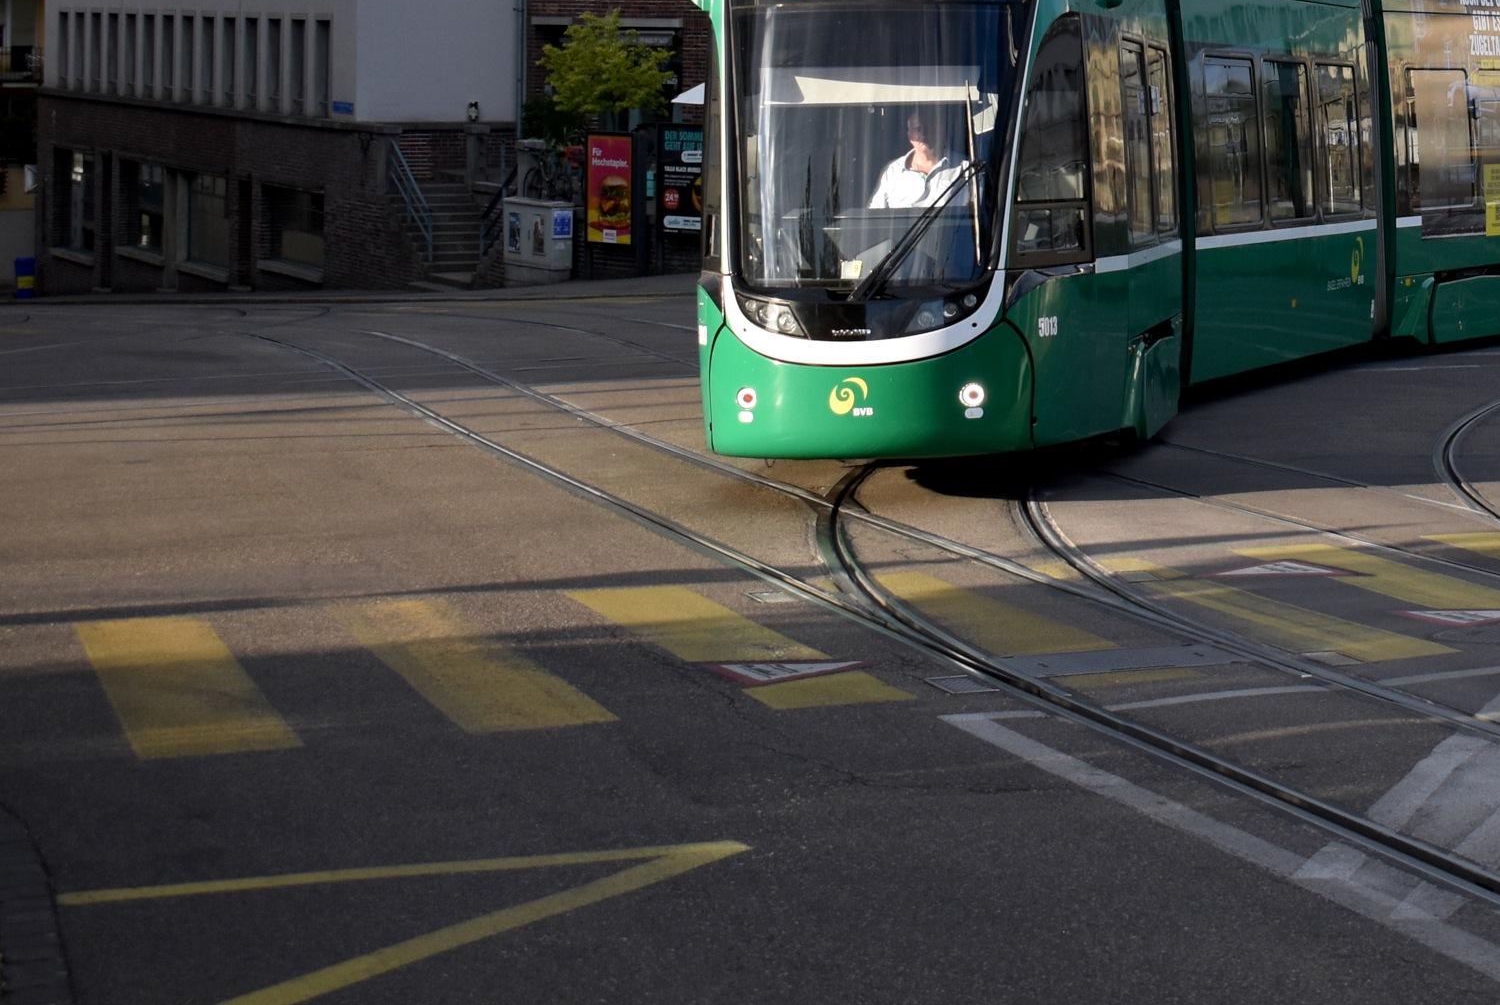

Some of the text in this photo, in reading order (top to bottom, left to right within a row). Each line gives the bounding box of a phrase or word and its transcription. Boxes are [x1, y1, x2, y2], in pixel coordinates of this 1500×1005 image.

[1472, 10, 1490, 31] GIBT
[664, 130, 678, 140] DER
[664, 141, 681, 151] GEHT
[592, 147, 602, 157] Für
[1038, 315, 1058, 337] 5013
[853, 407, 874, 416] BVB
